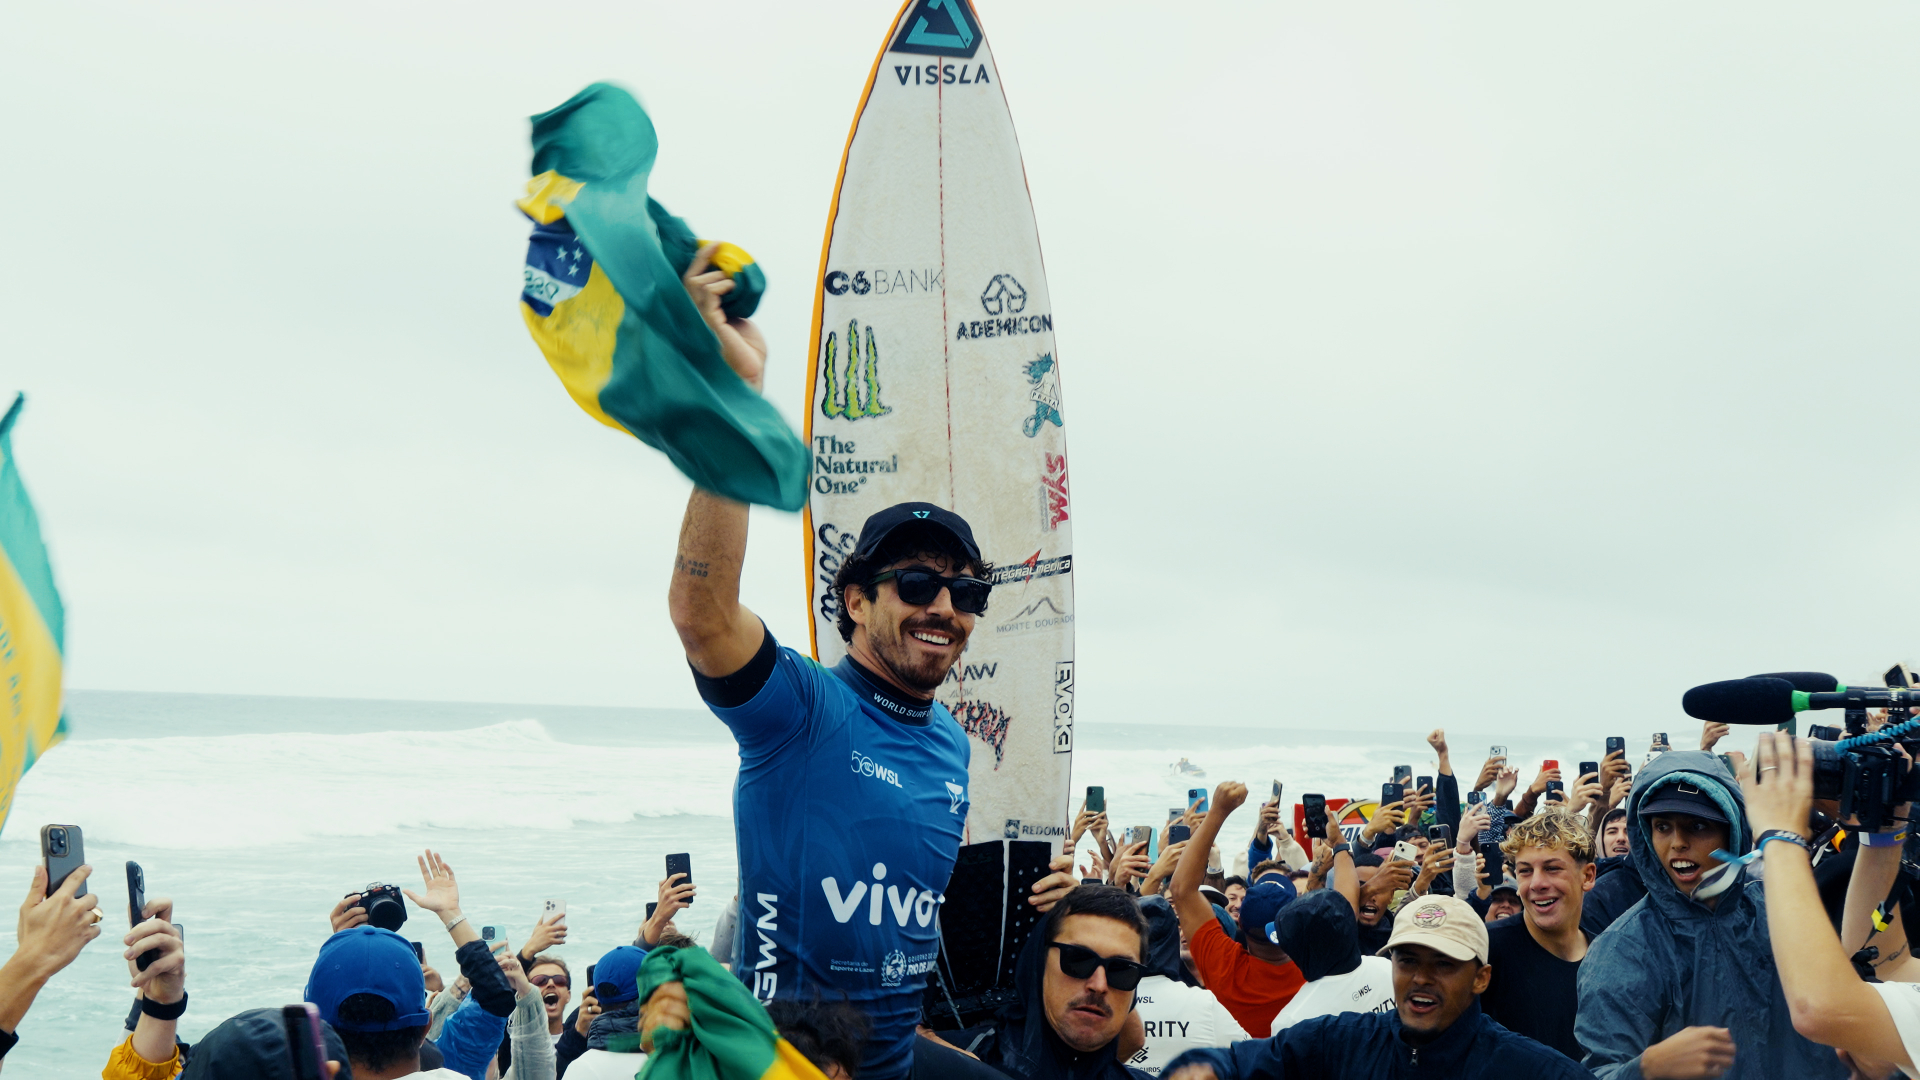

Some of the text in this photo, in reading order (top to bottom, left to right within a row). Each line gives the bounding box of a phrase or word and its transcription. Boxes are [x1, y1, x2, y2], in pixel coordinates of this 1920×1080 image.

[893, 63, 990, 86] VISSLA
[874, 267, 944, 295] BANK
[956, 313, 1053, 341] ADEMICON
[814, 434, 856, 454] The
[814, 453, 898, 475] Natural
[996, 620, 1031, 634] MONTE
[873, 692, 907, 715] WORLD
[875, 763, 903, 788] WSL
[1021, 825, 1065, 836] REDOMA
[820, 862, 936, 928] vivo
[753, 892, 778, 1007] GWM
